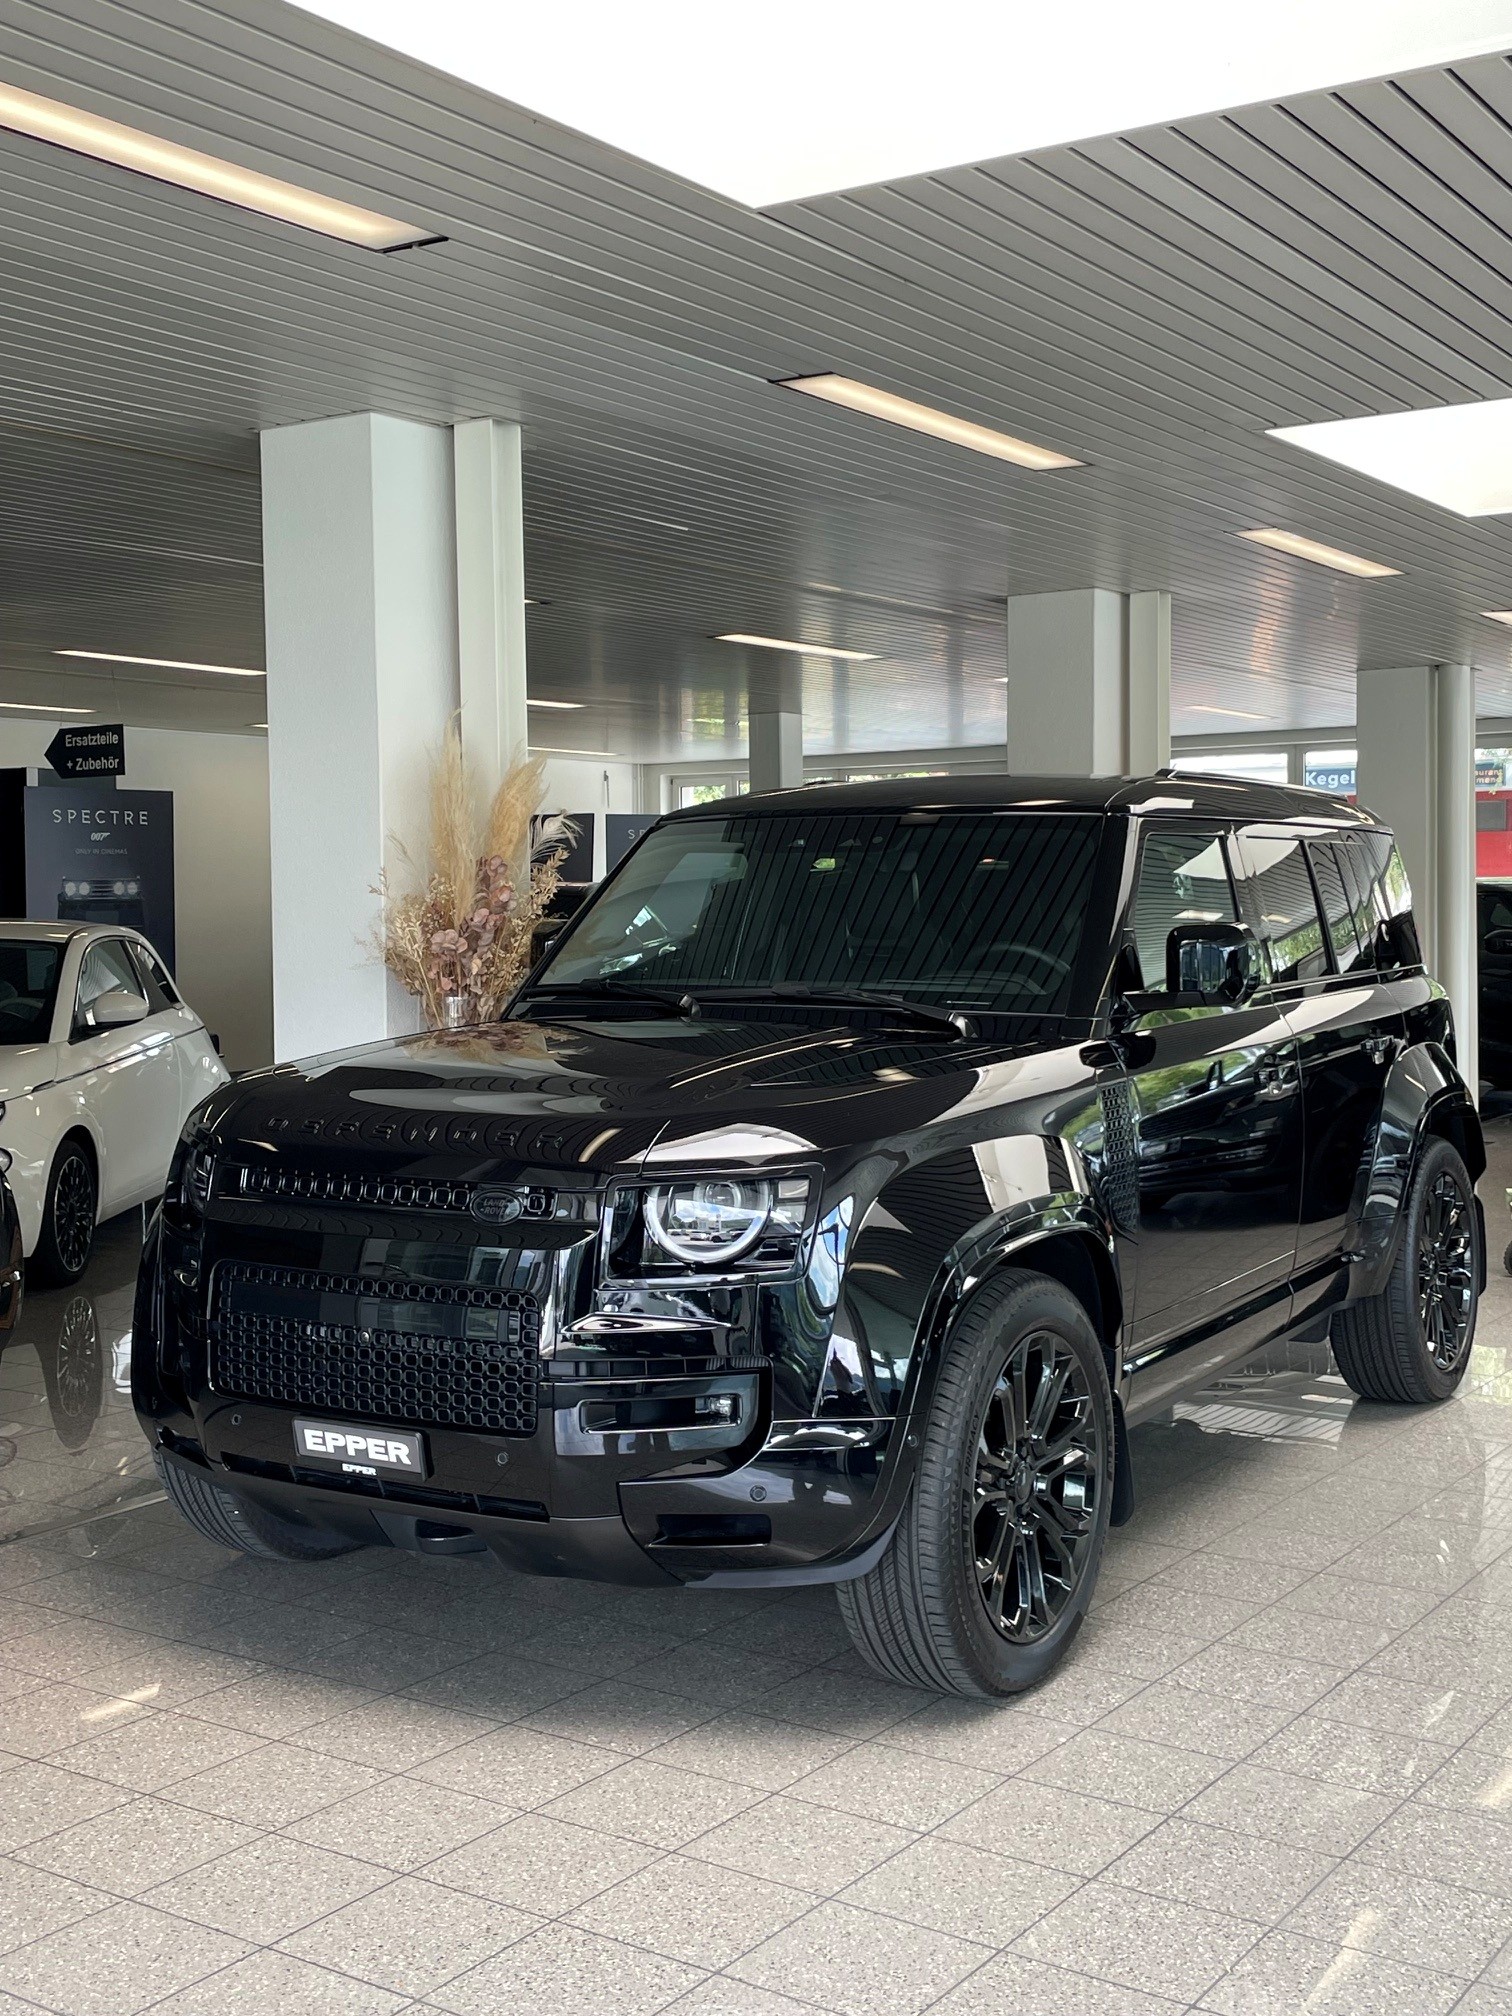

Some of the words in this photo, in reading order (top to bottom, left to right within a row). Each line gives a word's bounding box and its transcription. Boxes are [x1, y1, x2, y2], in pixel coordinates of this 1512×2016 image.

[65, 732, 119, 747] Ersatzteile
[67, 760, 73, 769] +
[75, 756, 120, 770] Zubehör
[1305, 769, 1356, 789] Kegel
[52, 809, 148, 826] SPECTRE
[90, 832, 110, 841] 007
[483, 1198, 505, 1206] LAND
[303, 1428, 412, 1466] EPPER
[963, 1409, 980, 1477] PRIMACY
[341, 1462, 377, 1476] EPPER
